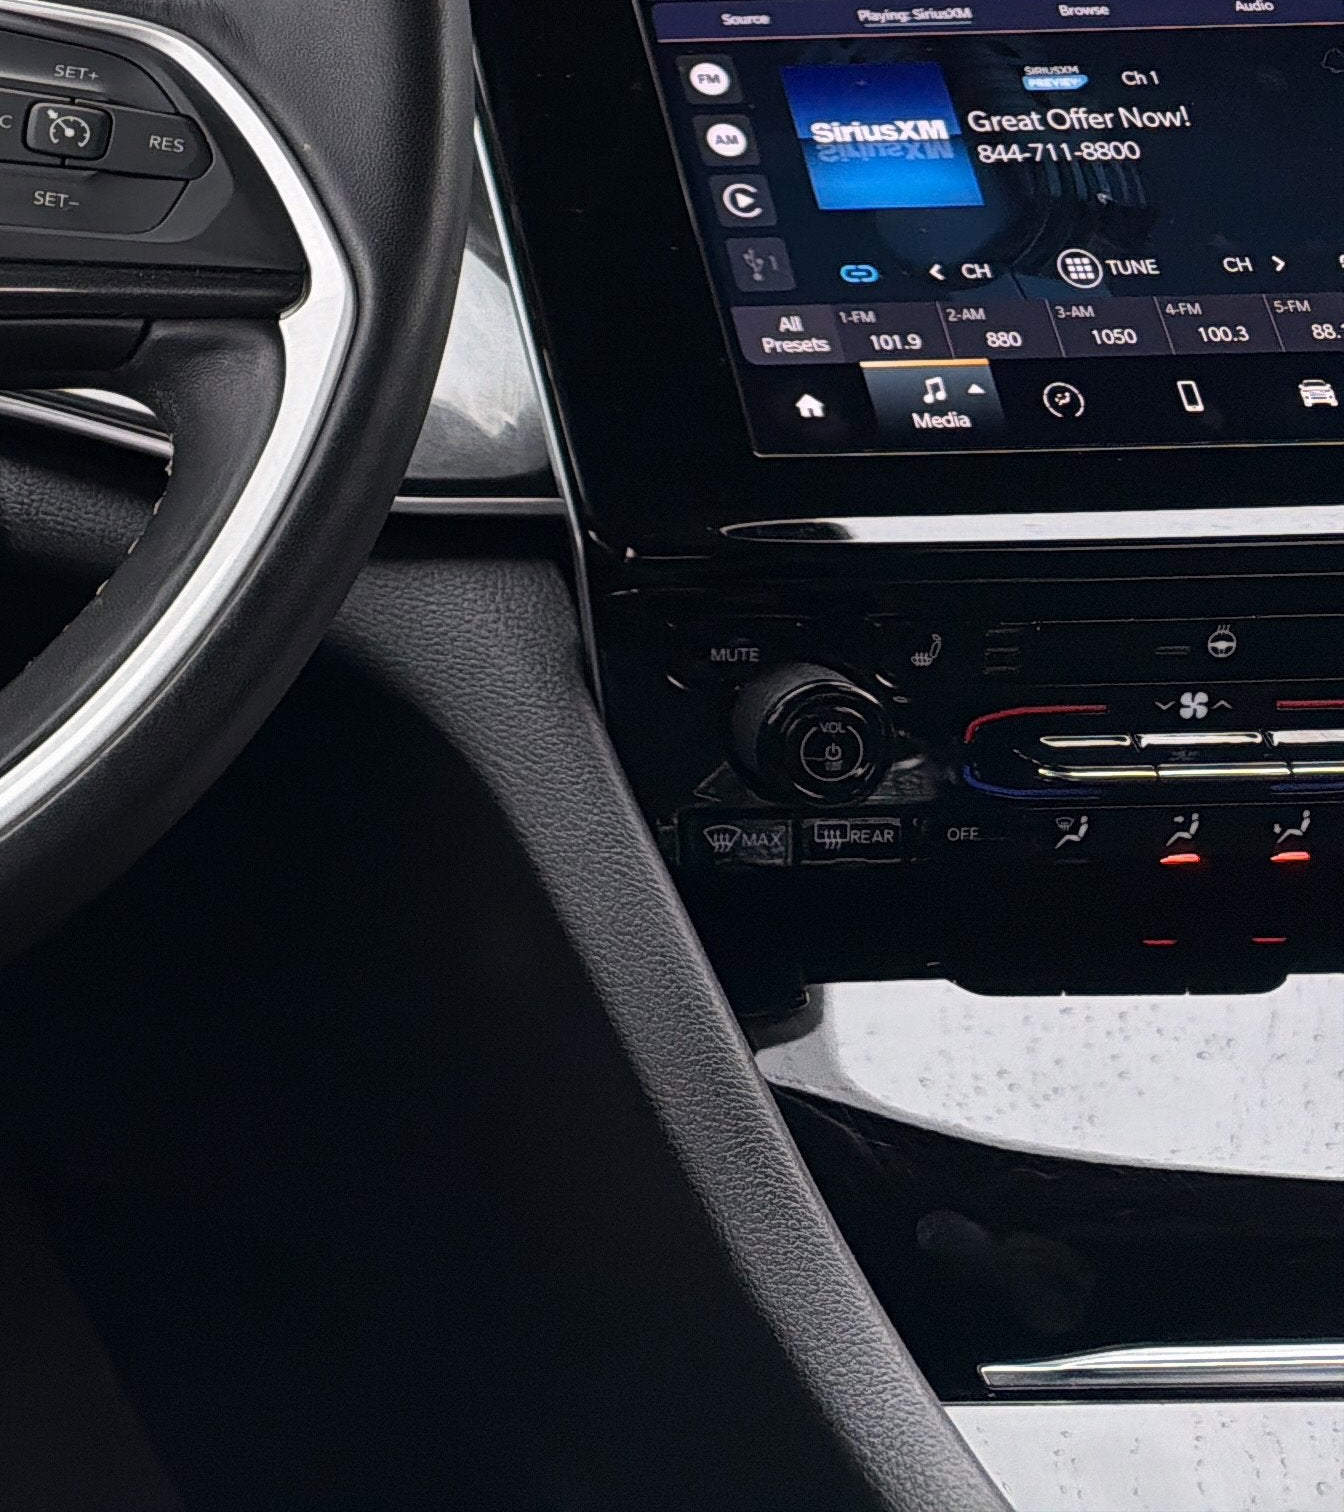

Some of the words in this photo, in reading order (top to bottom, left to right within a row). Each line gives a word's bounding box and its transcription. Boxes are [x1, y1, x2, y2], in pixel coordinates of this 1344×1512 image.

[1058, 3, 1110, 17] Browse
[1235, 0, 1275, 13] Audio
[721, 14, 771, 26] Source
[858, 9, 910, 24] Playing:
[912, 7, 974, 21] SiriusXM
[53, 63, 100, 81] SET+
[697, 74, 721, 85] FM
[1121, 71, 1147, 86] Ch
[1150, 71, 1160, 86] 1
[967, 109, 1045, 133] Great
[1047, 107, 1113, 131] Offer
[1118, 105, 1192, 129] Now!
[714, 133, 739, 145] AM
[811, 120, 951, 144] SiriusXM
[148, 134, 185, 154] RES
[978, 141, 1141, 164] 844-711-8800
[961, 262, 994, 280] CH
[1105, 258, 1161, 276] TUNE
[1223, 256, 1254, 273] CH
[946, 307, 987, 323] 2-AM
[1055, 305, 1096, 320] 3-AM
[1165, 302, 1203, 317] 4-FM
[1273, 299, 1312, 315] 5-FM
[778, 315, 805, 333] All
[839, 311, 876, 325] 1-FM
[869, 333, 923, 352] 101.9
[985, 331, 1023, 348] 880
[1091, 328, 1138, 346] 1050
[1197, 326, 1250, 344] 100.3
[762, 337, 831, 355] Presets
[912, 412, 972, 429] Media
[710, 647, 761, 663] MUTE
[819, 721, 848, 735] VOL
[740, 832, 783, 849] MAX
[849, 829, 895, 845] REAR
[946, 827, 980, 842] OFF
